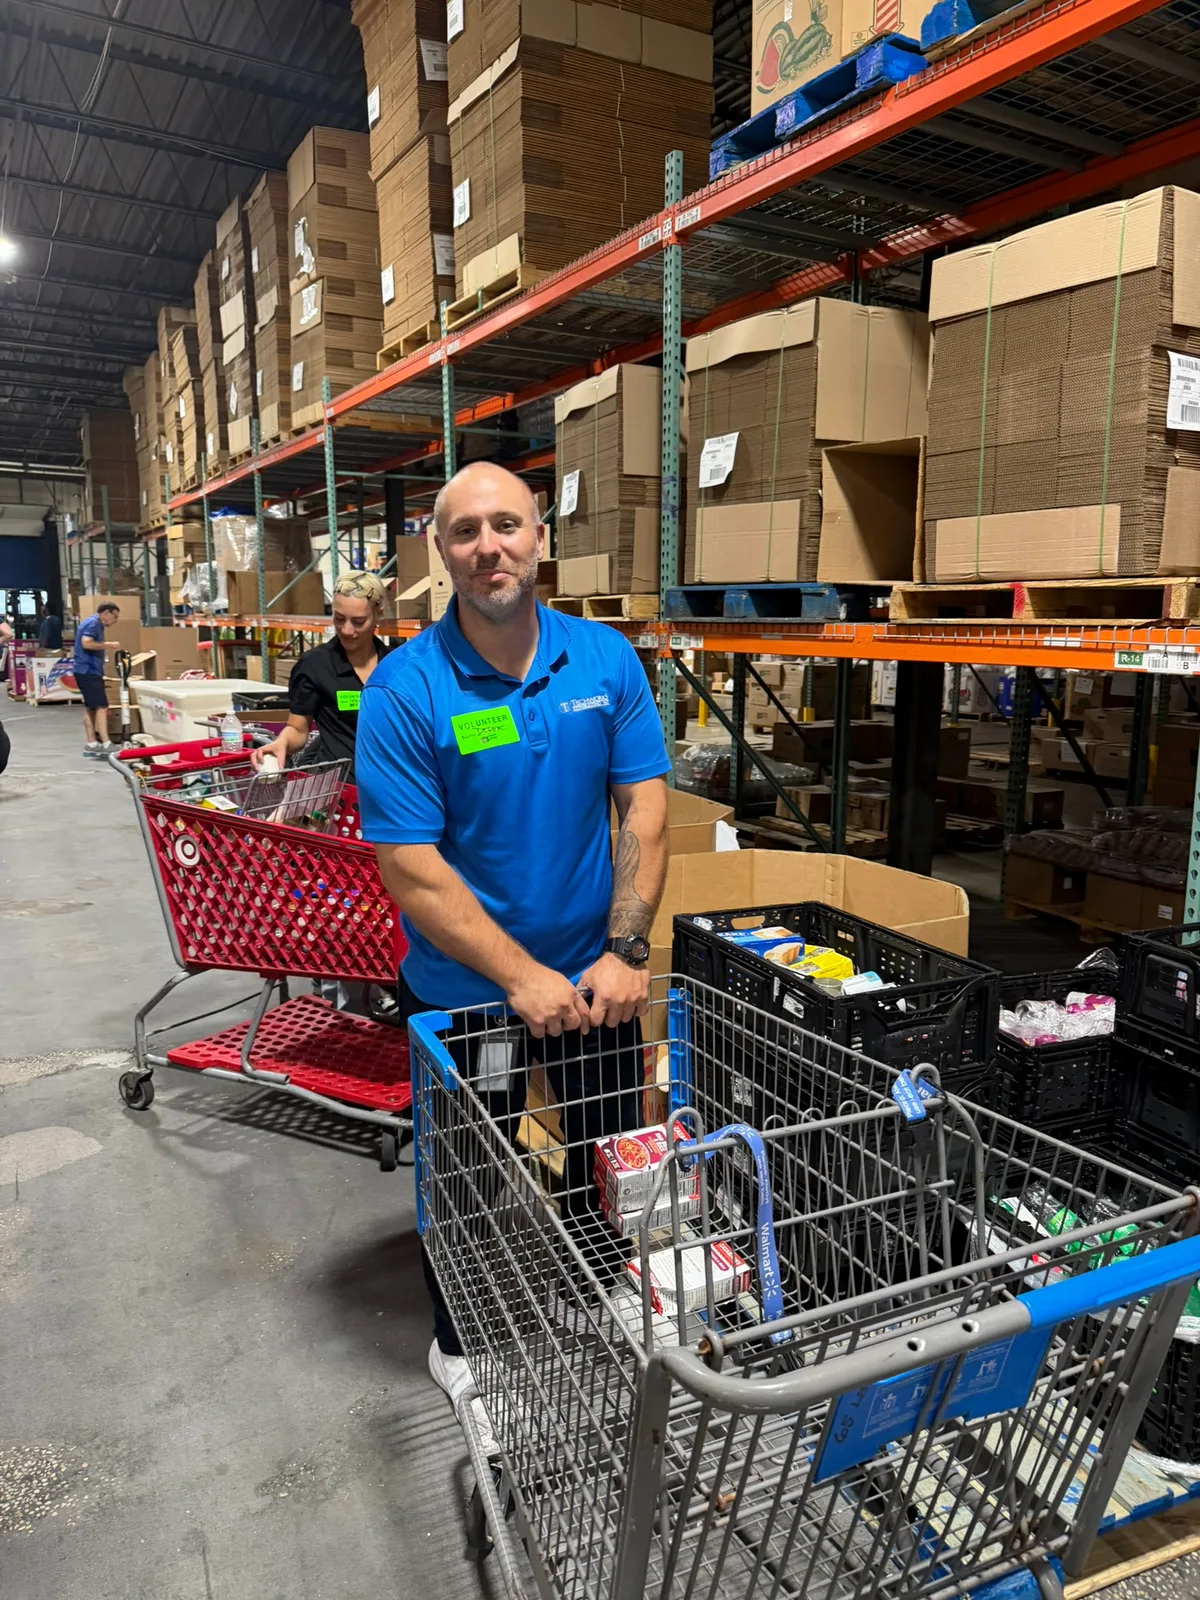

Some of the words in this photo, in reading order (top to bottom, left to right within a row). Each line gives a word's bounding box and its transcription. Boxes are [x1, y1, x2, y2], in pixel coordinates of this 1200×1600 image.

[1121, 653, 1140, 663] R-14
[1162, 651, 1169, 659] A
[1183, 662, 1189, 670] B
[457, 714, 509, 731] VOLUNTEER
[761, 1221, 775, 1278] Walmart
